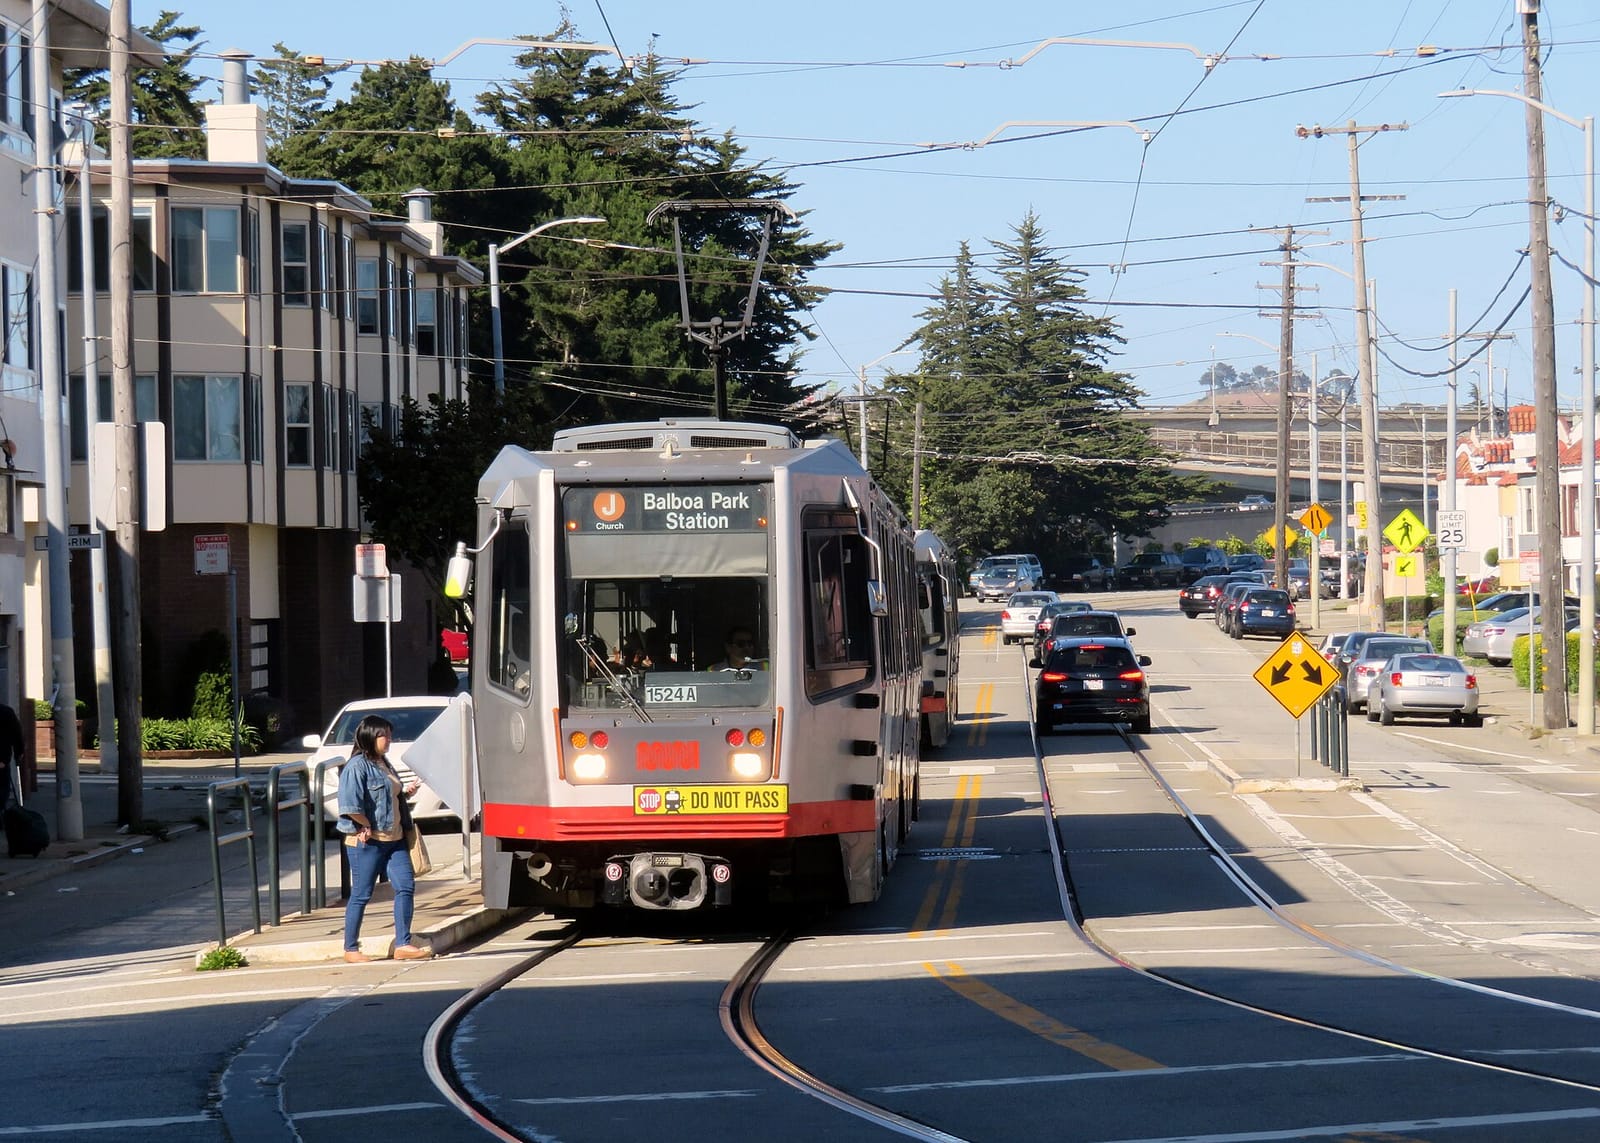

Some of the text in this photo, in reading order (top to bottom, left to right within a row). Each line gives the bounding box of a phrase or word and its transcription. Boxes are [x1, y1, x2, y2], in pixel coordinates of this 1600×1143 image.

[601, 494, 616, 516] J
[644, 491, 749, 510] Balboa Park
[595, 522, 624, 530] Church
[666, 512, 729, 530] Station
[1440, 529, 1464, 543] 25
[640, 793, 660, 808] STOP
[691, 790, 779, 809] DO NOT PASS
